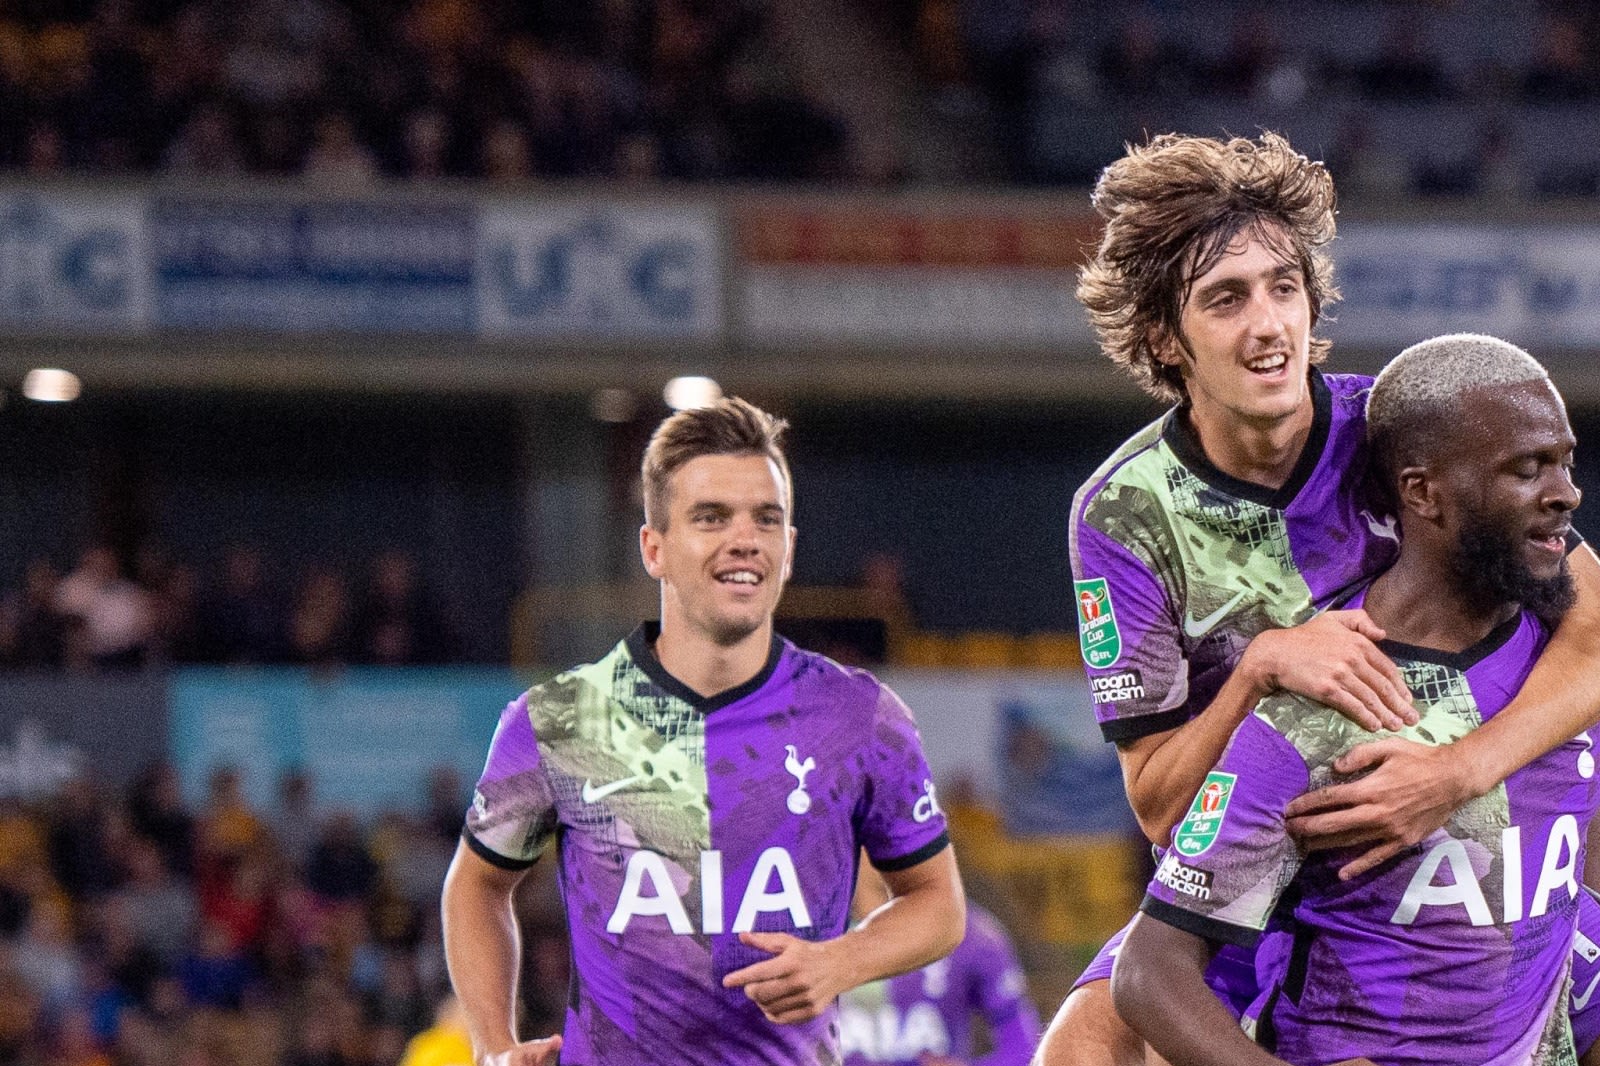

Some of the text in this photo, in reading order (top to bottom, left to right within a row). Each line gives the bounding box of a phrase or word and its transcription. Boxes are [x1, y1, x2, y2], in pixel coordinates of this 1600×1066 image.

[1086, 629, 1104, 643] Cup
[606, 846, 814, 936] AIA
[1389, 814, 1580, 926] AIA
